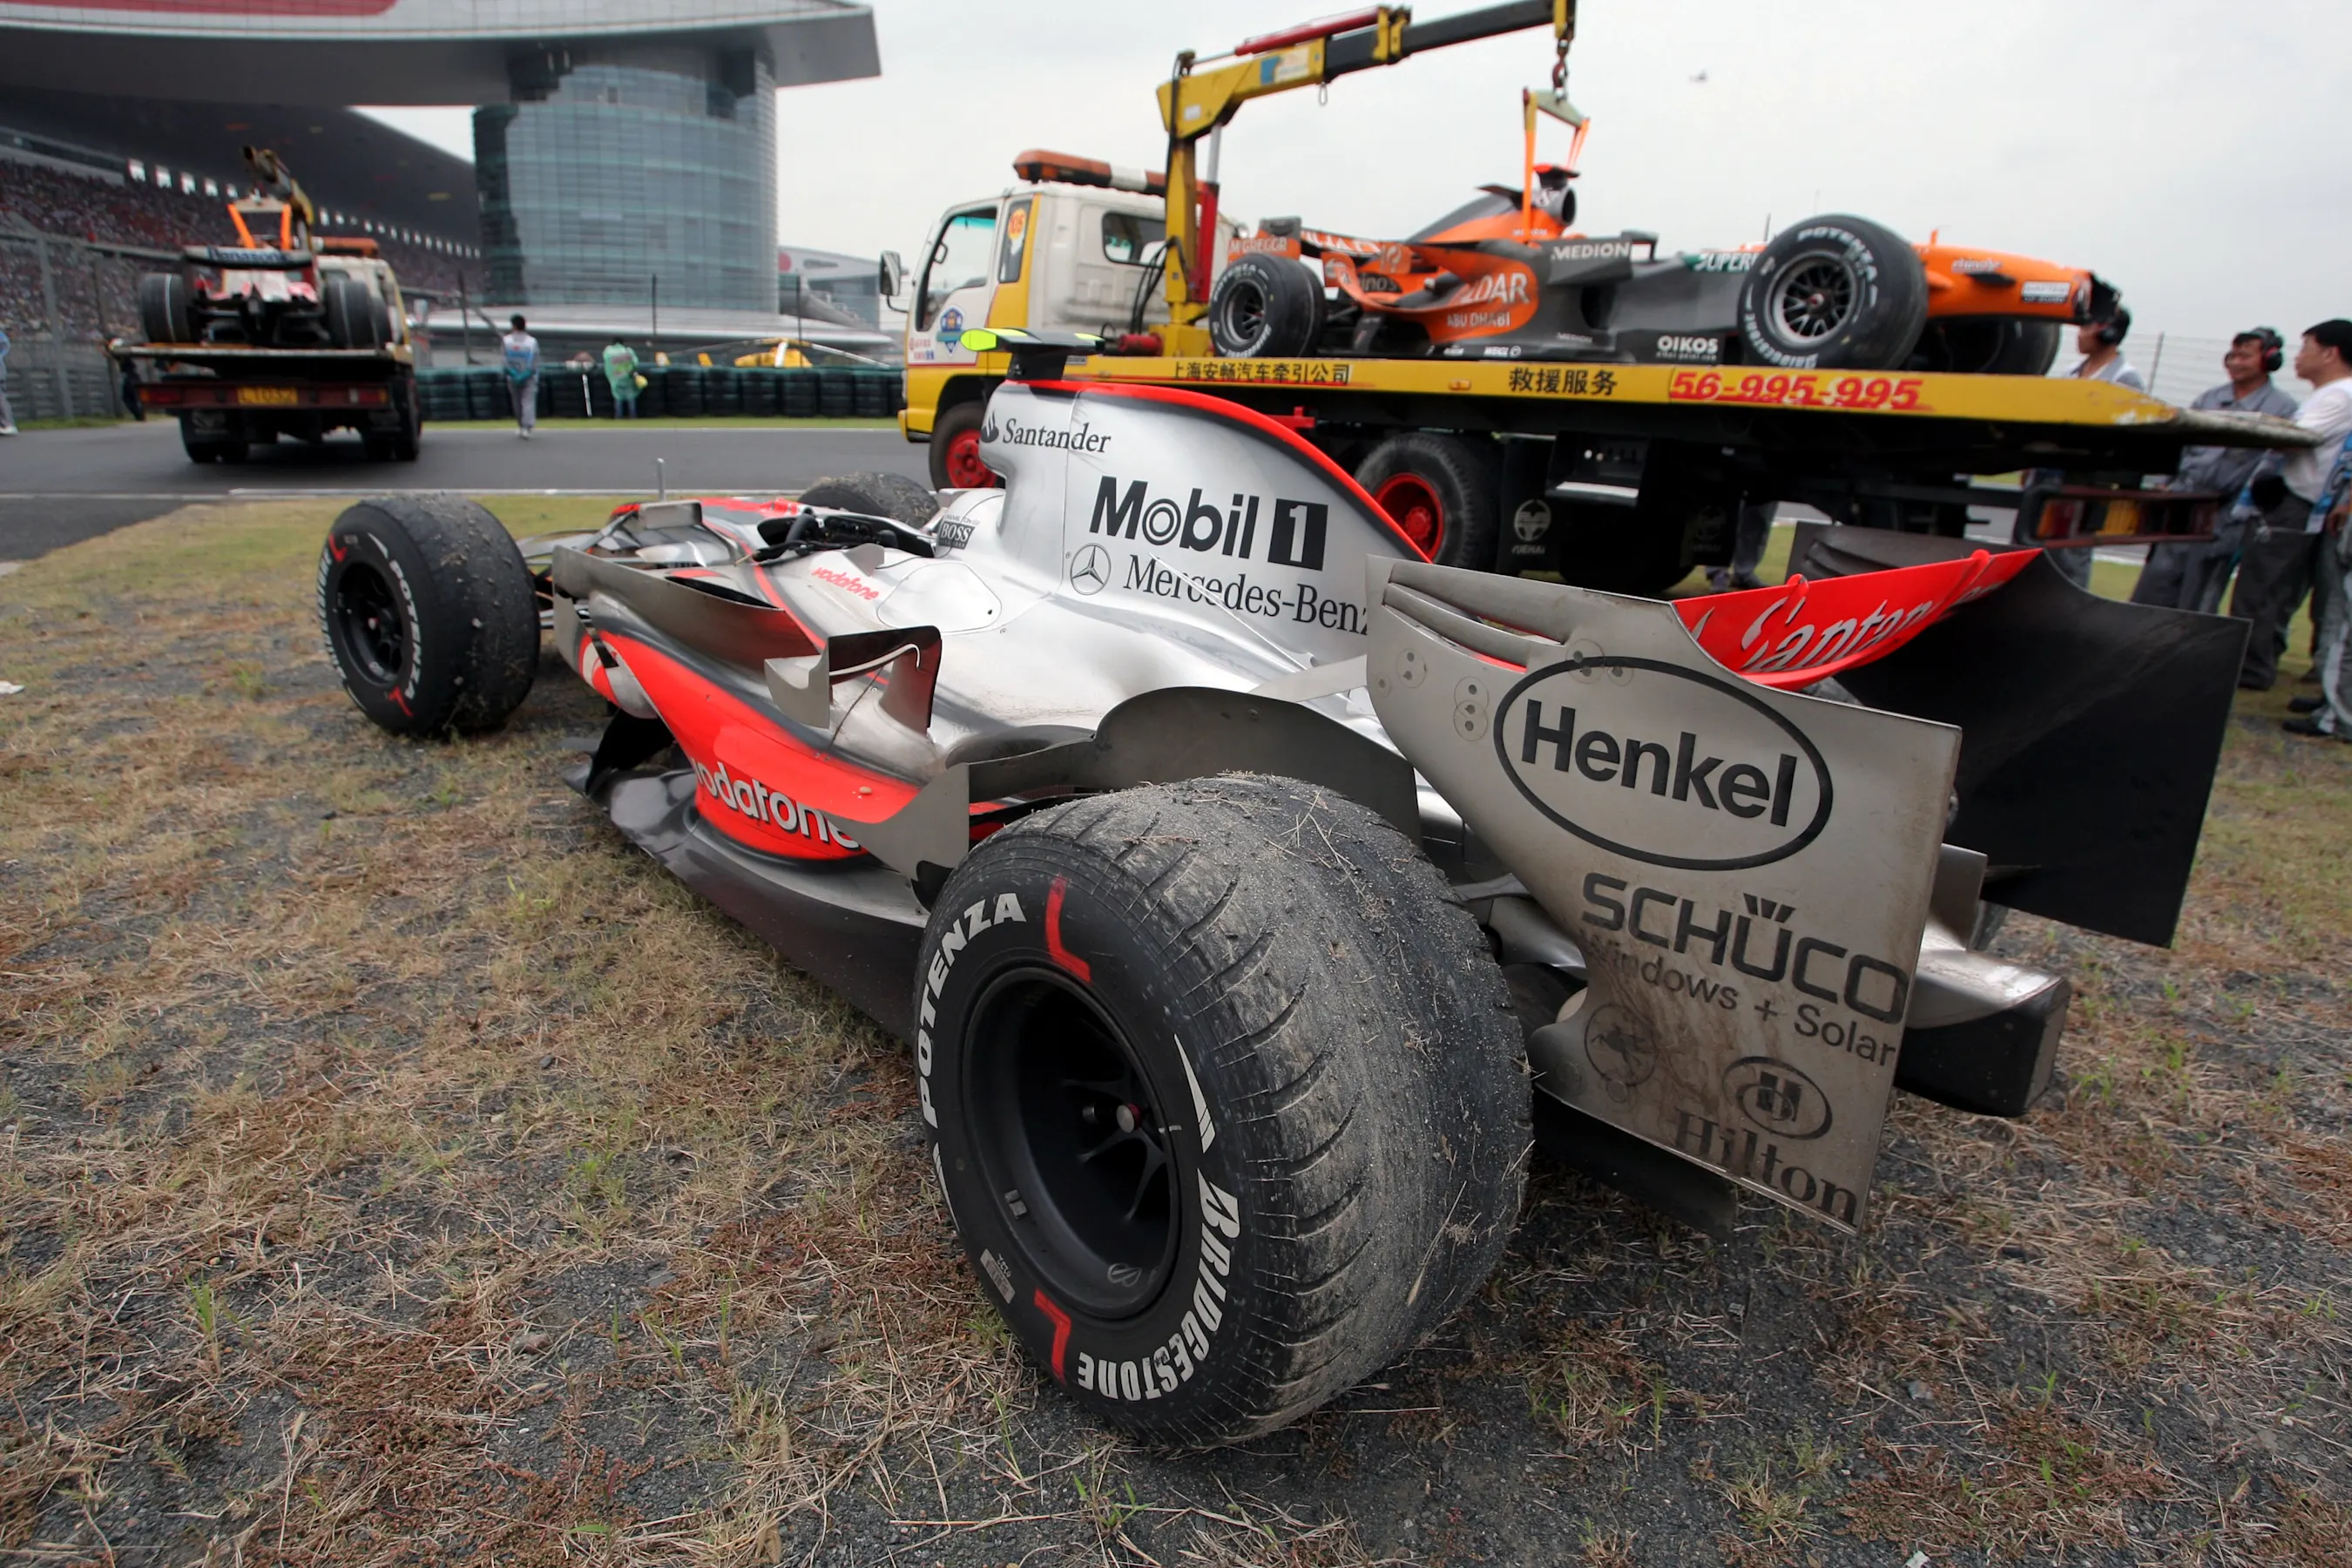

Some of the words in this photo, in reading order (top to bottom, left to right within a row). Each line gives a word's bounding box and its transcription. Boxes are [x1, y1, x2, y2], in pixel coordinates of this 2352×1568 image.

[1551, 242, 1631, 260] MEDION
[1798, 226, 1878, 283] POTENZA
[1447, 314, 1468, 328] ABU
[1470, 312, 1511, 328] DHABI
[1658, 335, 1719, 355] OIKOS
[1744, 314, 1820, 369] BRIDGESTONE
[1174, 361, 1351, 385] 上海安畅汽车牵引公司
[1509, 367, 1619, 397] 救援服务
[1671, 370, 1924, 411] 56-995-995
[1003, 419, 1111, 454] Santander
[941, 523, 972, 542] BOSS
[1089, 476, 1260, 560] Mobil
[810, 566, 880, 601] vodafone
[389, 559, 422, 700] POTENZA
[1521, 698, 1798, 828] Henkel
[1581, 872, 1909, 1024] SCHÜCO
[917, 892, 1027, 1129] POTENZA
[1754, 1000, 1778, 1022] +
[1794, 1004, 1896, 1066] Solar
[1673, 1108, 1859, 1225] Hilton
[1077, 1167, 1240, 1402] BRIDGESTONE
